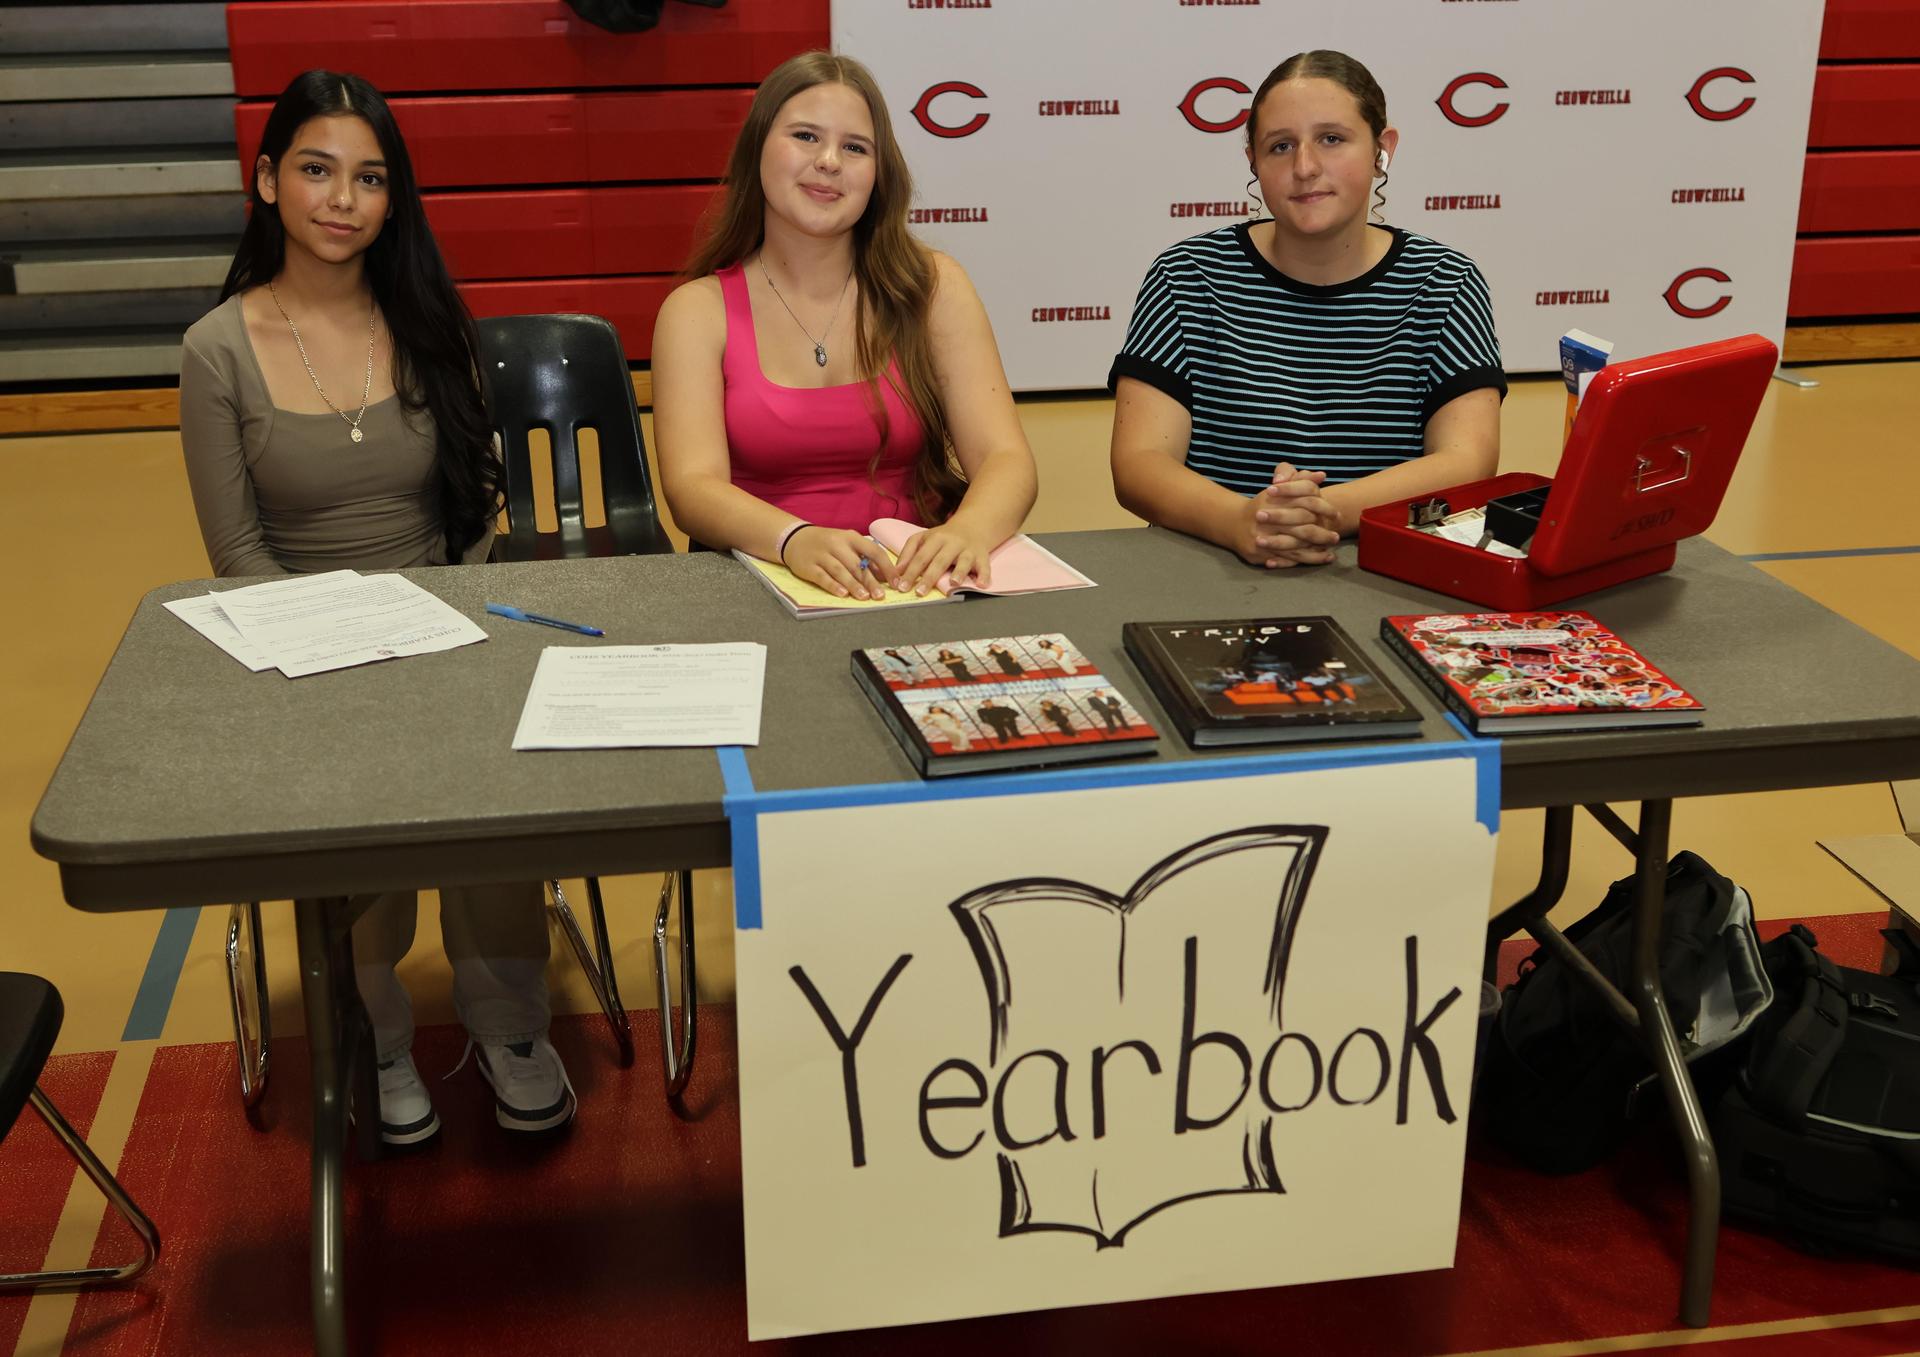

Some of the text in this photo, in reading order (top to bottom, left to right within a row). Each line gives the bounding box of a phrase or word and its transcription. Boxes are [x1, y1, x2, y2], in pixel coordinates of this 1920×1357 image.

[1555, 90, 1631, 106] CHOWCHILLA
[1039, 99, 1120, 116] CHOWCHILLA
[1425, 195, 1501, 211] CHOWCHILLA
[1671, 188, 1745, 203] CHOWCHILLA
[908, 207, 988, 223] CHOWCHILLA
[1170, 202, 1249, 218] CHOWCHILLA
[1535, 290, 1610, 305] CHOWCHILLA
[1032, 306, 1111, 322] CHOWCHILLA
[788, 936, 1462, 1168] Yearbook
